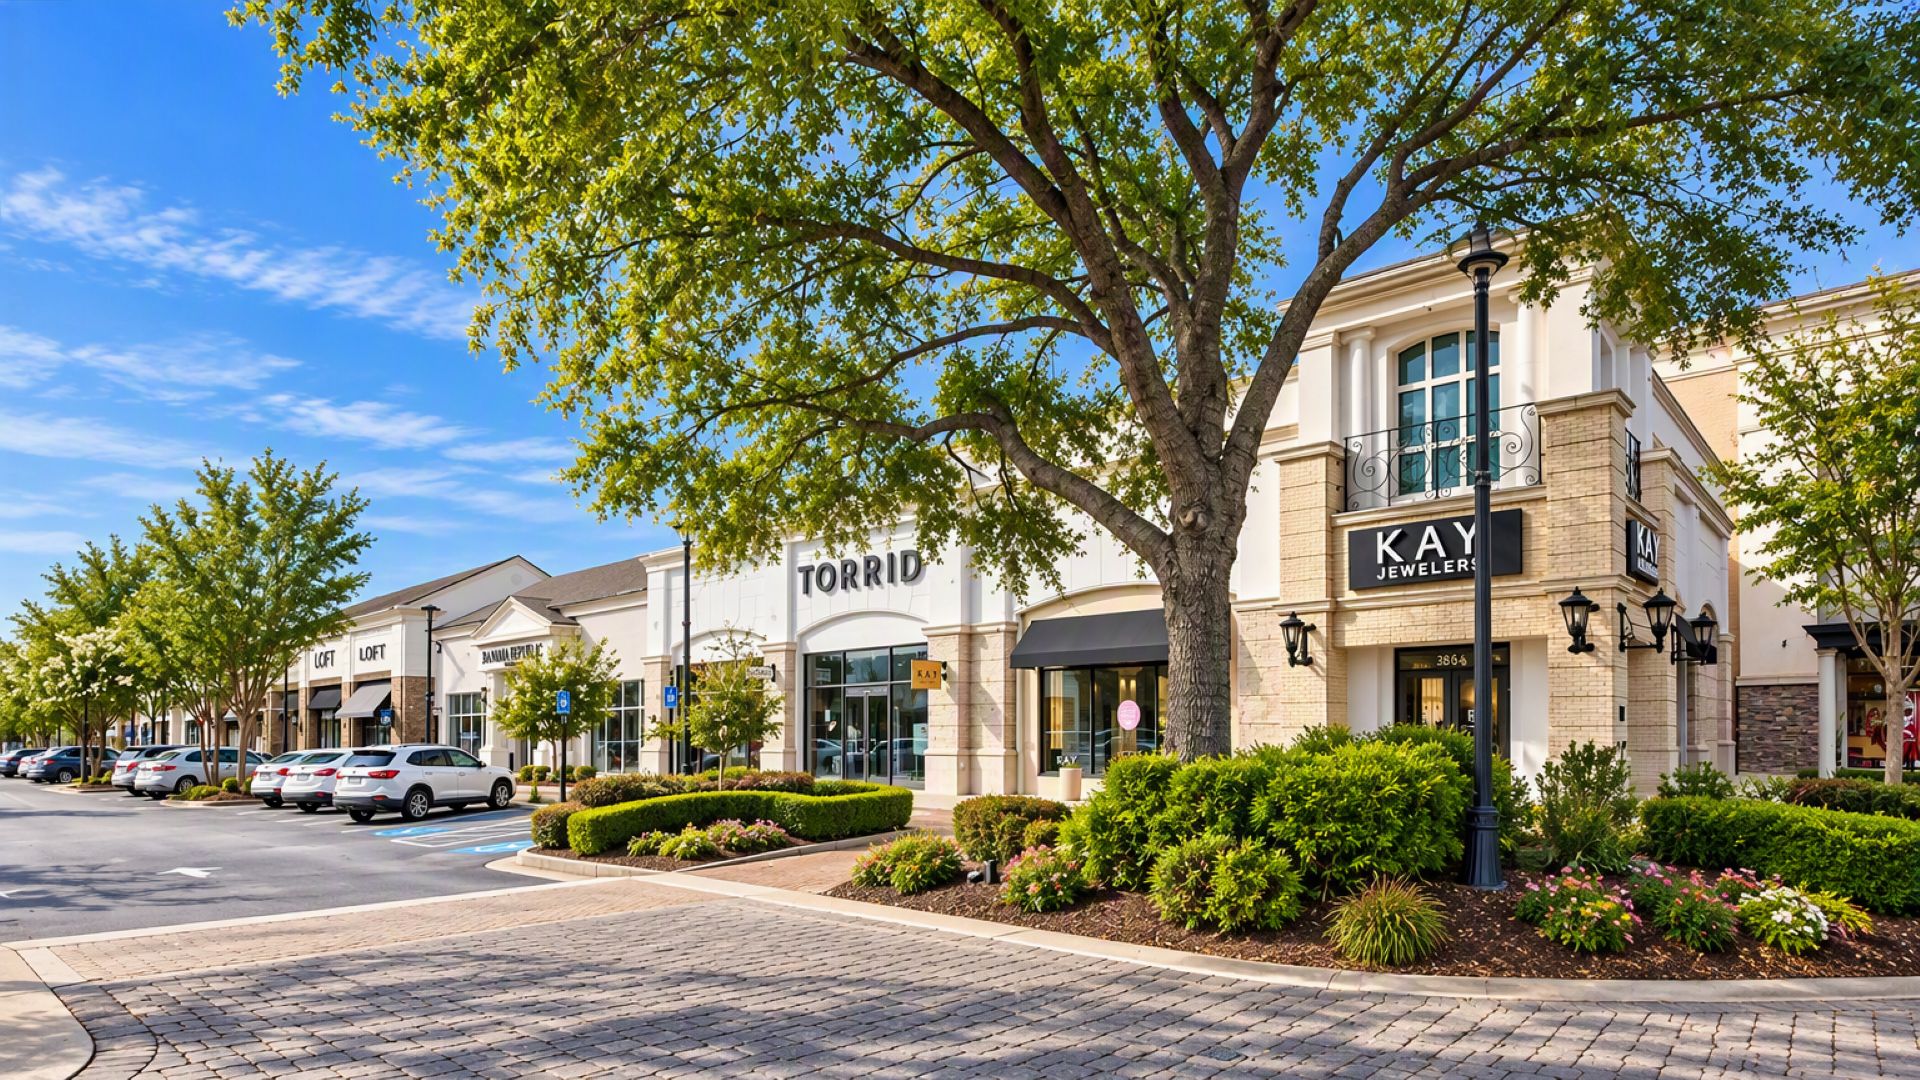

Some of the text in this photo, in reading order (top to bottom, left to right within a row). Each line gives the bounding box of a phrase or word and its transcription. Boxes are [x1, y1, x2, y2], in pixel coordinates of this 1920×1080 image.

[1376, 521, 1475, 565] KAY
[1637, 521, 1660, 564] KAY
[797, 550, 921, 595] TORRID
[1376, 558, 1475, 581] JEWELERS
[314, 650, 335, 669] LOFT
[359, 643, 386, 661] LOFT
[510, 642, 543, 661] REPUBIC
